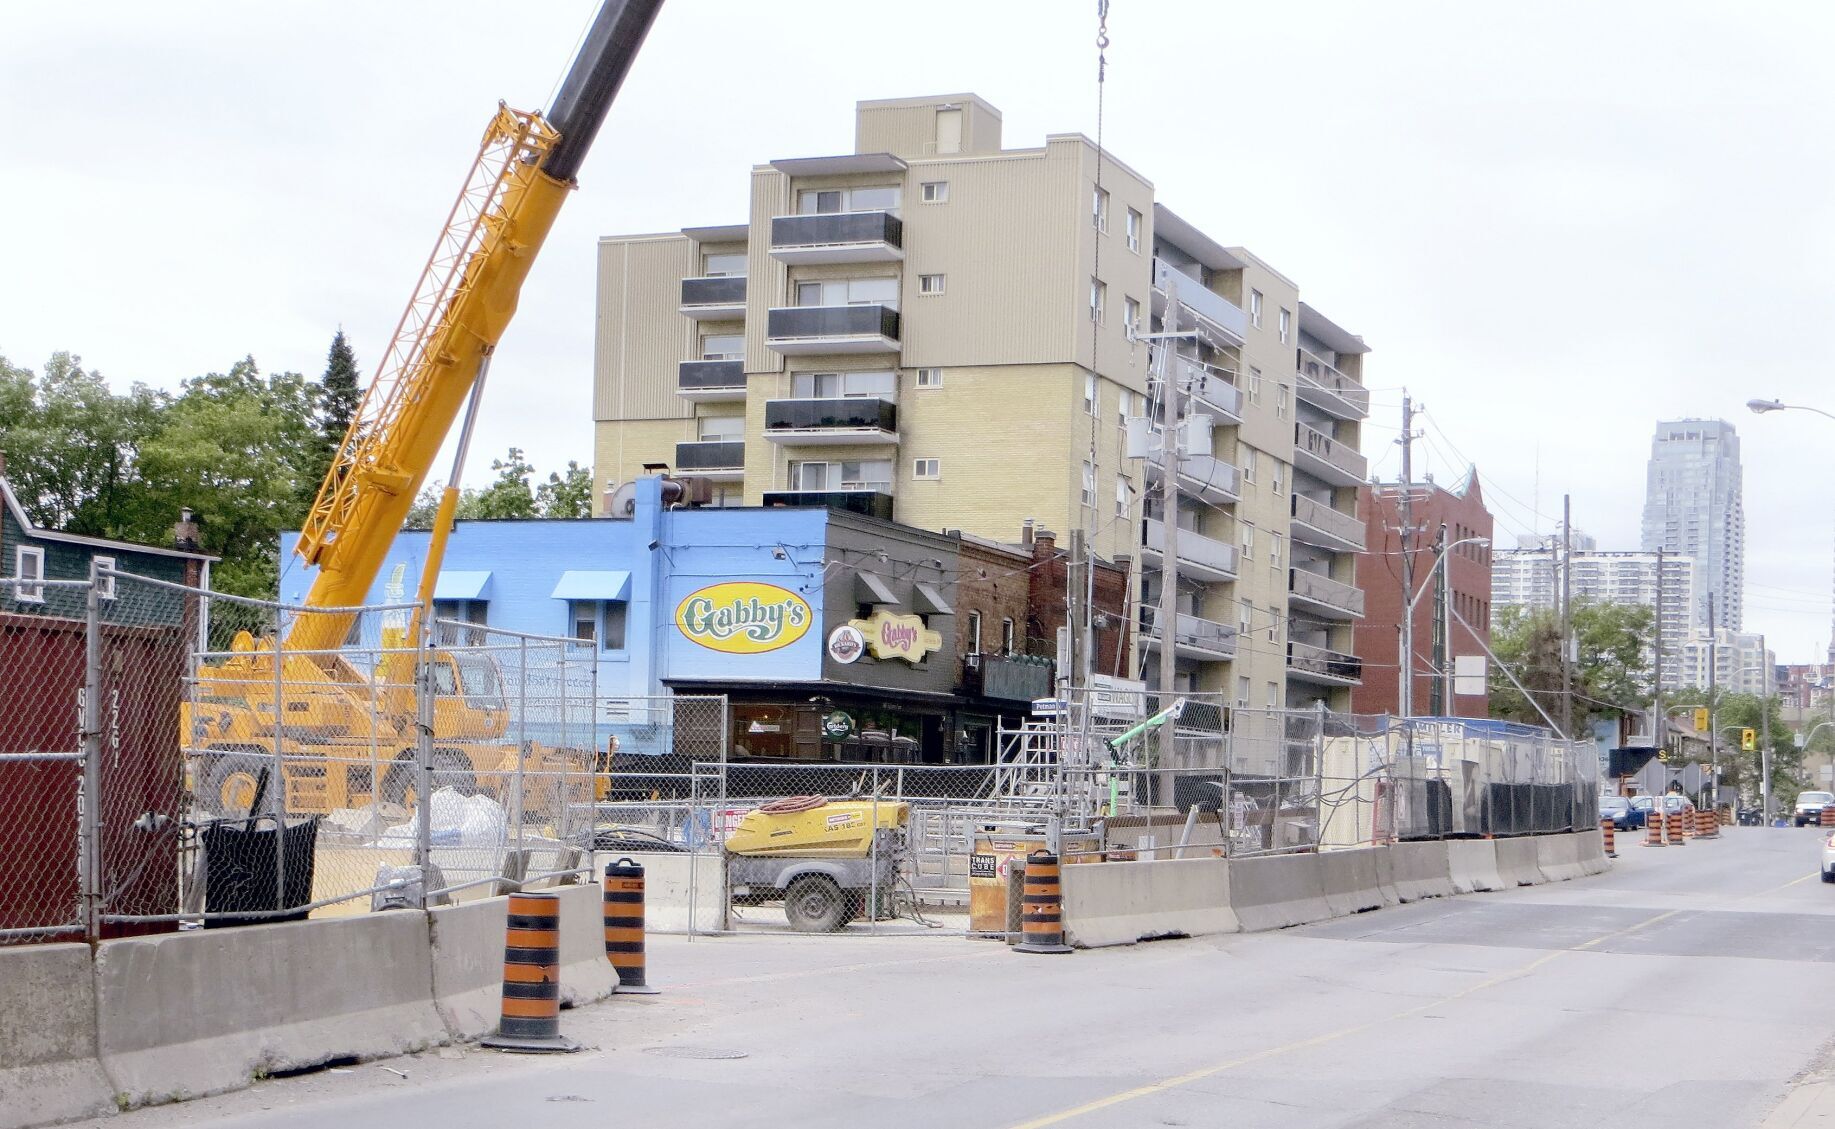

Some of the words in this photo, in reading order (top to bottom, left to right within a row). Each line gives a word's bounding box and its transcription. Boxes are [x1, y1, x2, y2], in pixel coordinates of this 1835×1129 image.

[682, 596, 805, 643] Gabby's
[881, 620, 918, 652] Gabby's
[971, 856, 995, 864] TRANS
[971, 863, 995, 871] CUBE
